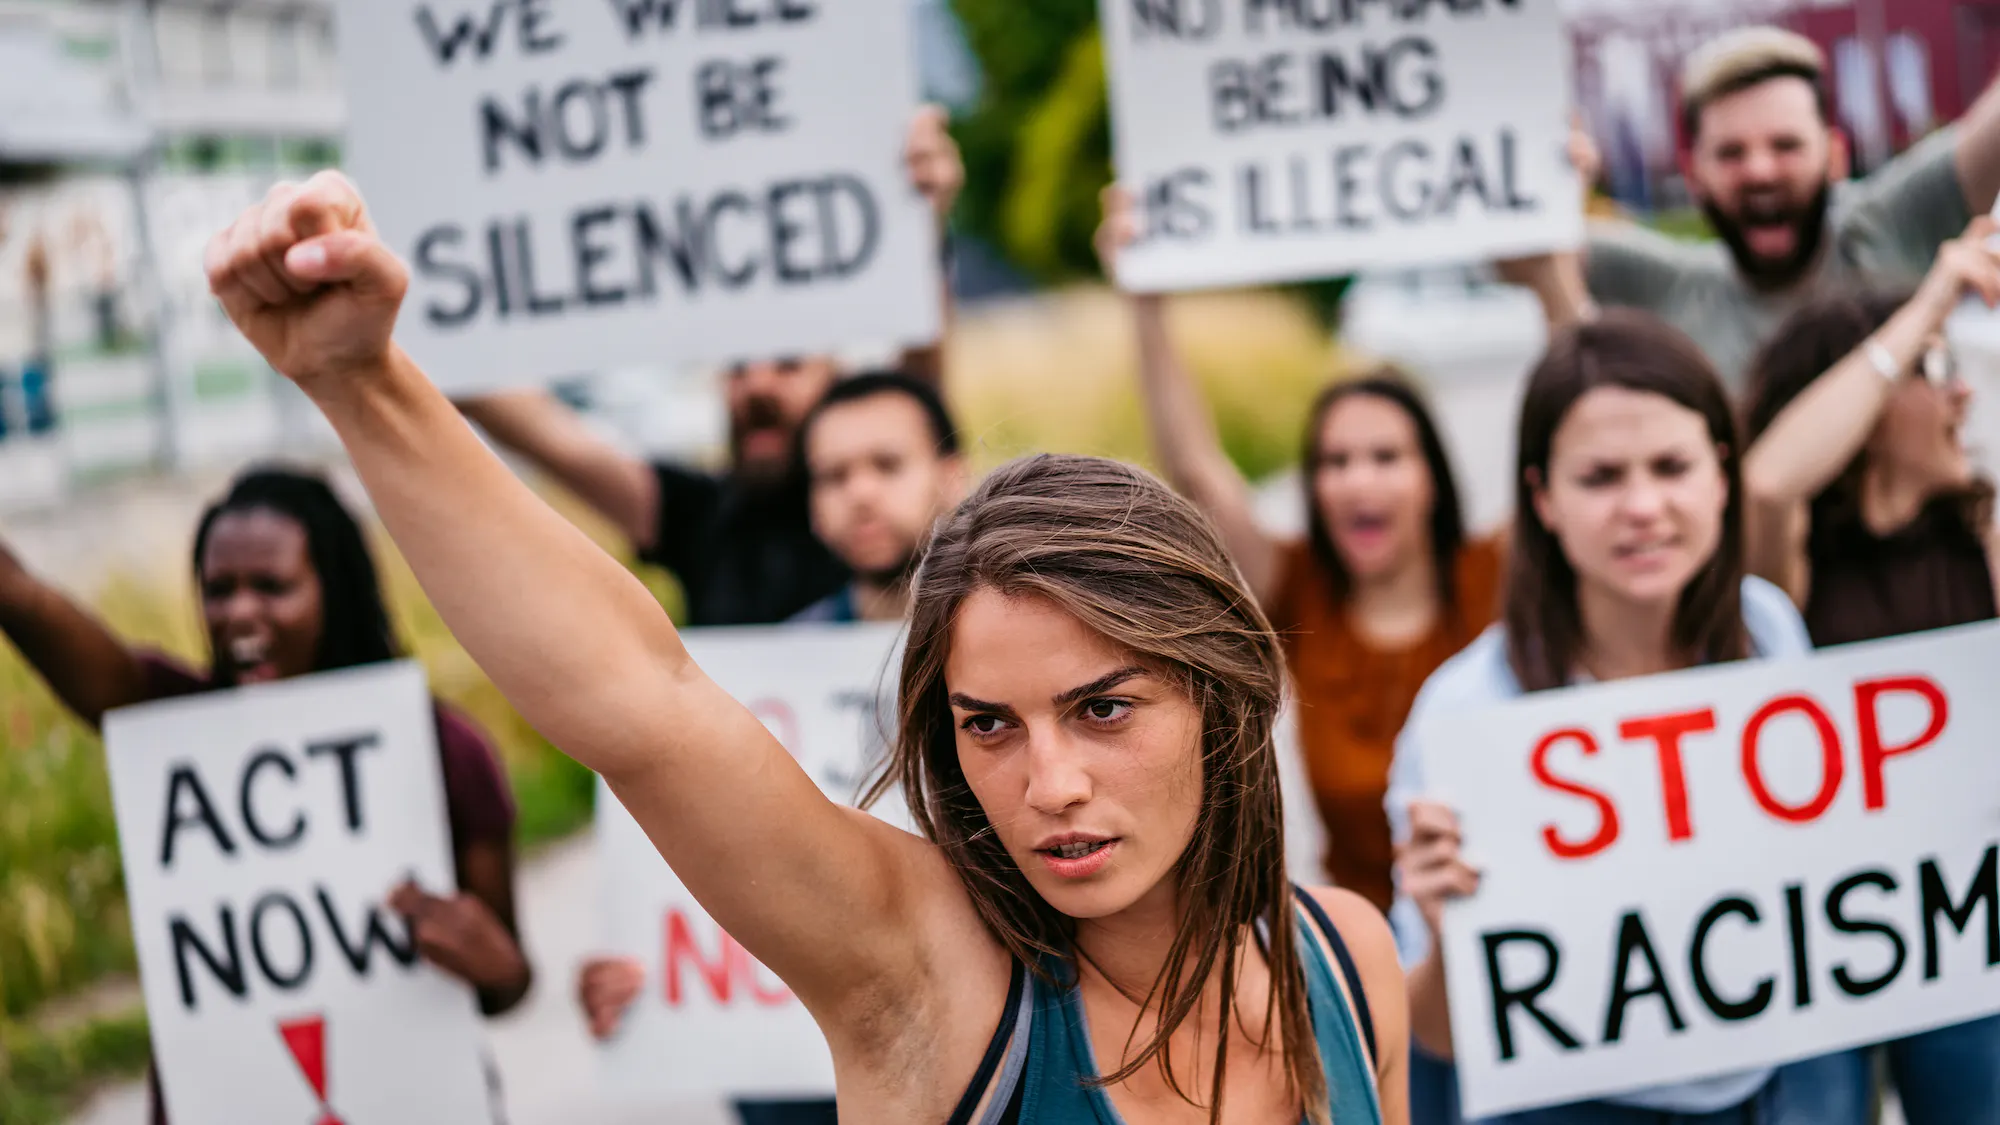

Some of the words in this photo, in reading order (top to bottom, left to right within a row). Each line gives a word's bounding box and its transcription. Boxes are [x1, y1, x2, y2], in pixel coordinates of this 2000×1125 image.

[412, 0, 565, 65] WE
[1210, 36, 1446, 131] BEING
[478, 70, 650, 174] NOT
[696, 56, 794, 139] BE
[1147, 165, 1214, 240] IS
[1235, 128, 1537, 235] ILLEGAL
[413, 172, 883, 329] SILENCED
[160, 732, 384, 868] ACT
[1528, 674, 1950, 860] STOP
[170, 868, 424, 1011] NOW
[1480, 842, 2000, 1062] RACISM
[276, 1012, 348, 1125] !
